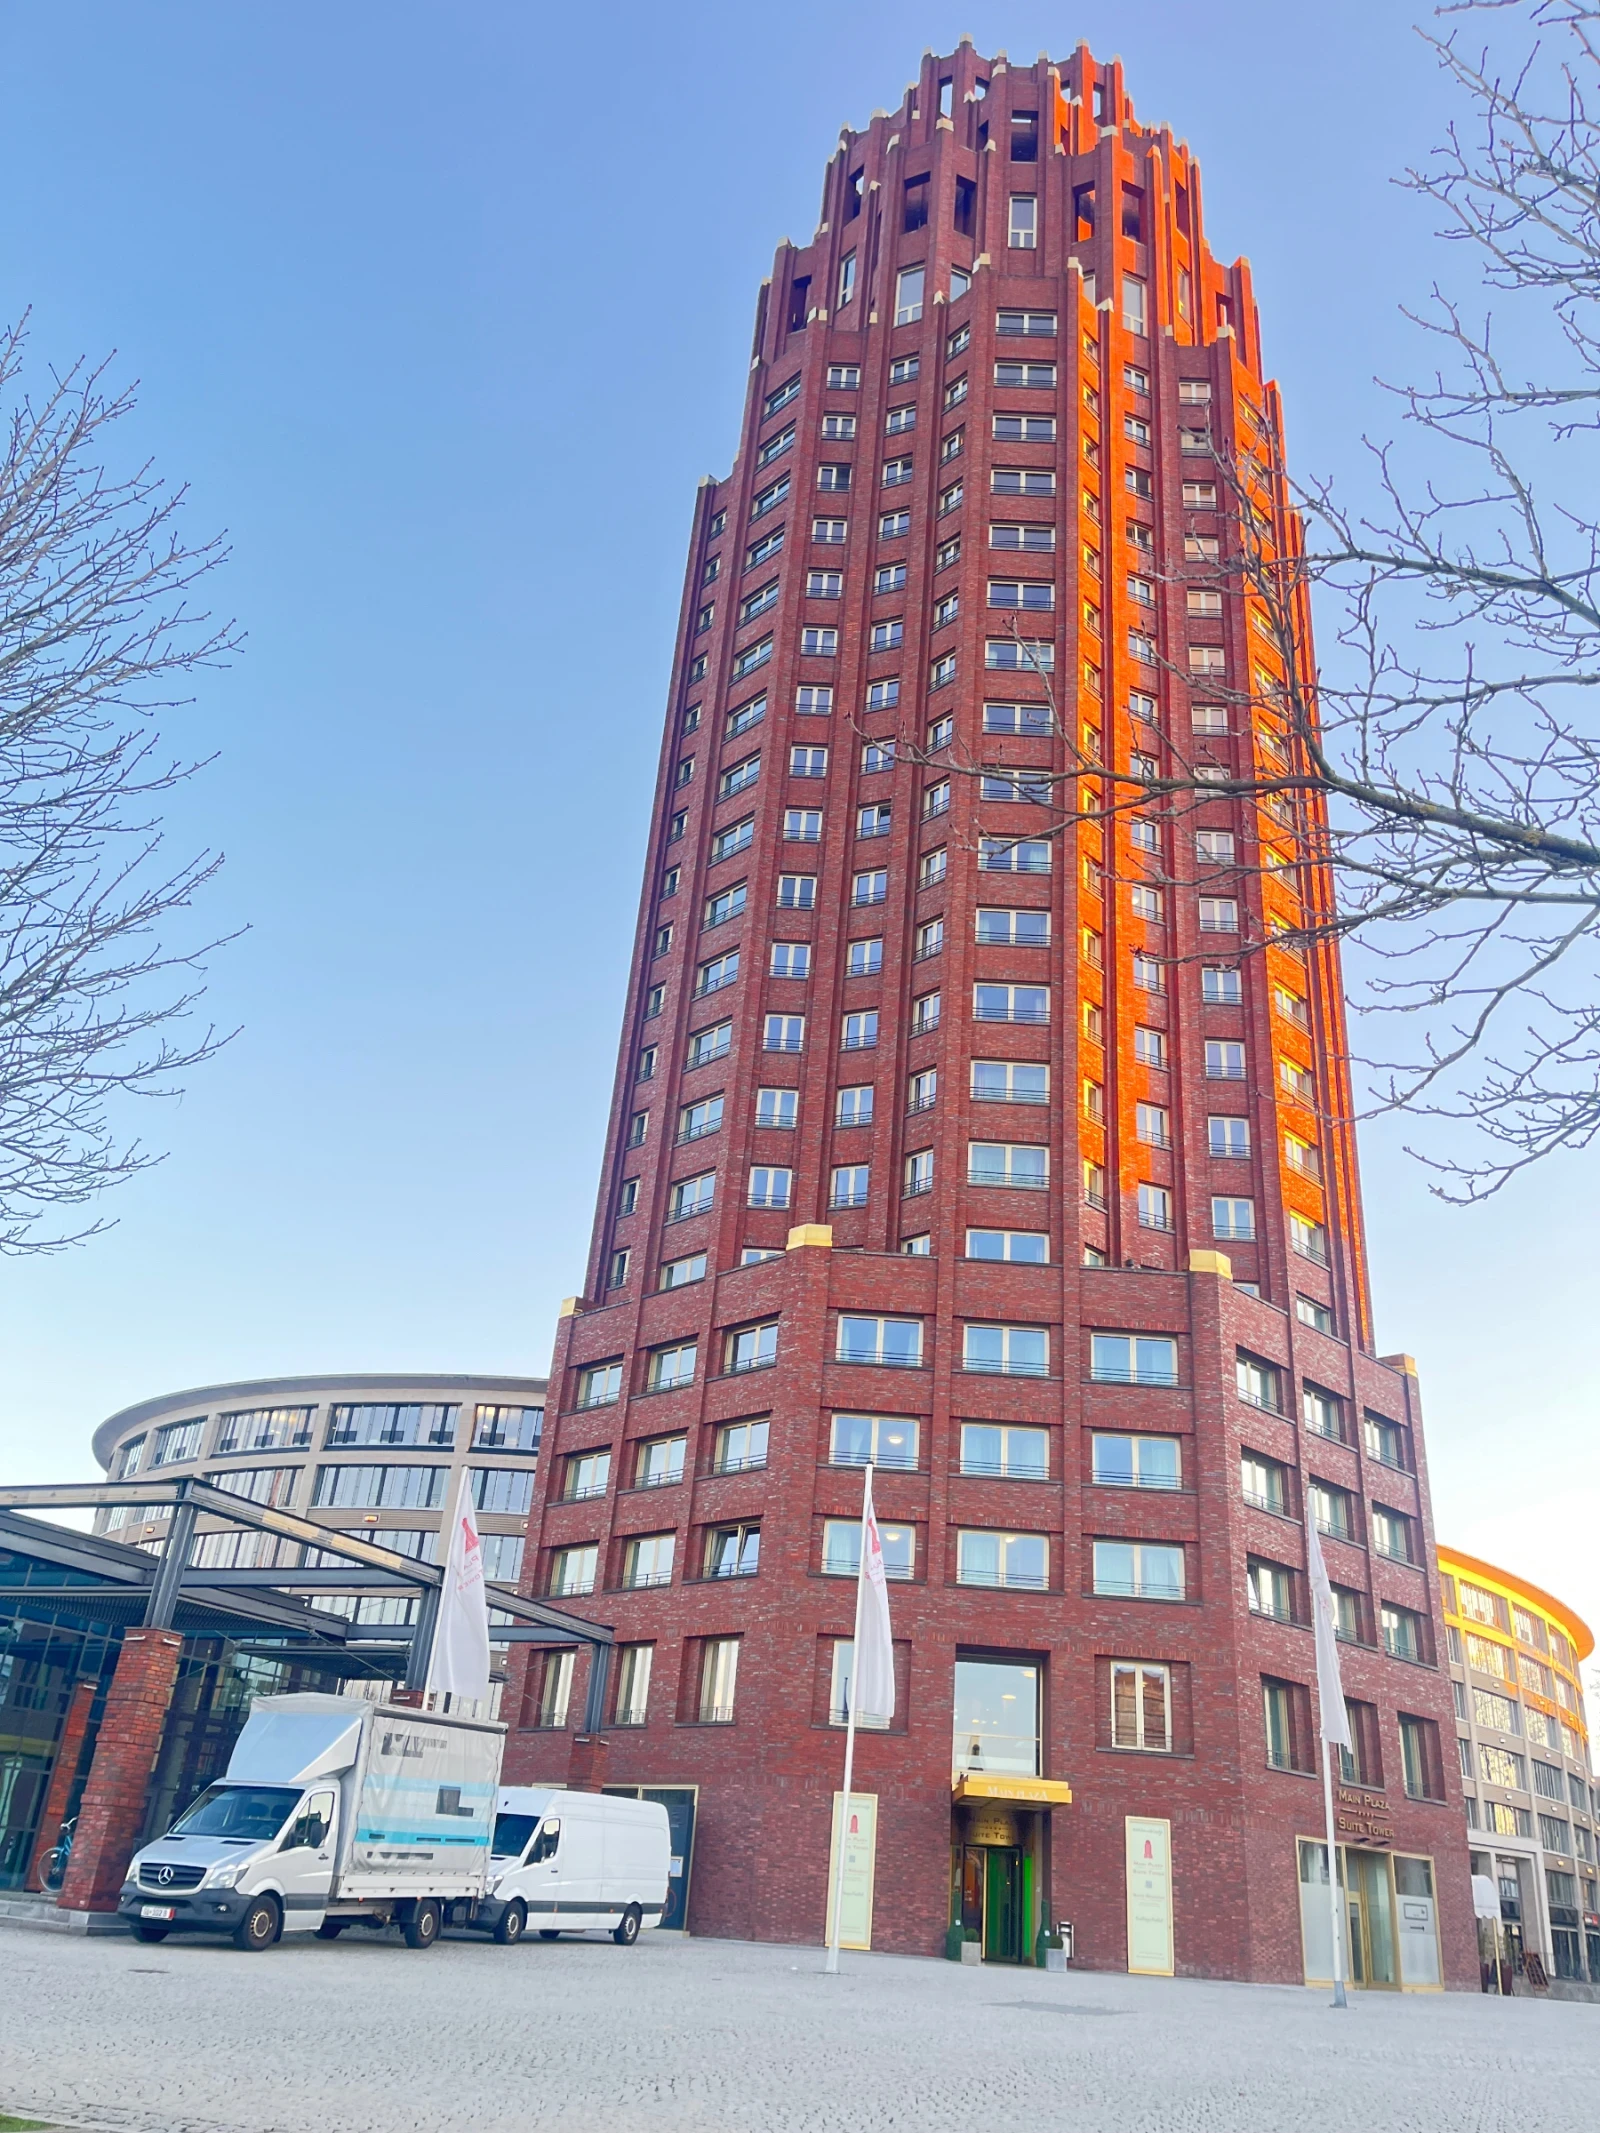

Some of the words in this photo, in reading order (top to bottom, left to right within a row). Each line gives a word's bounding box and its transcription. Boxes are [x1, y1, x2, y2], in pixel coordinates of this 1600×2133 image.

[1338, 1789, 1361, 1804] MAIN
[1363, 1794, 1391, 1809] PLAZA
[993, 1832, 1015, 1840] TOW
[1338, 1816, 1365, 1833] SUITE
[1366, 1821, 1395, 1838] TOWER
